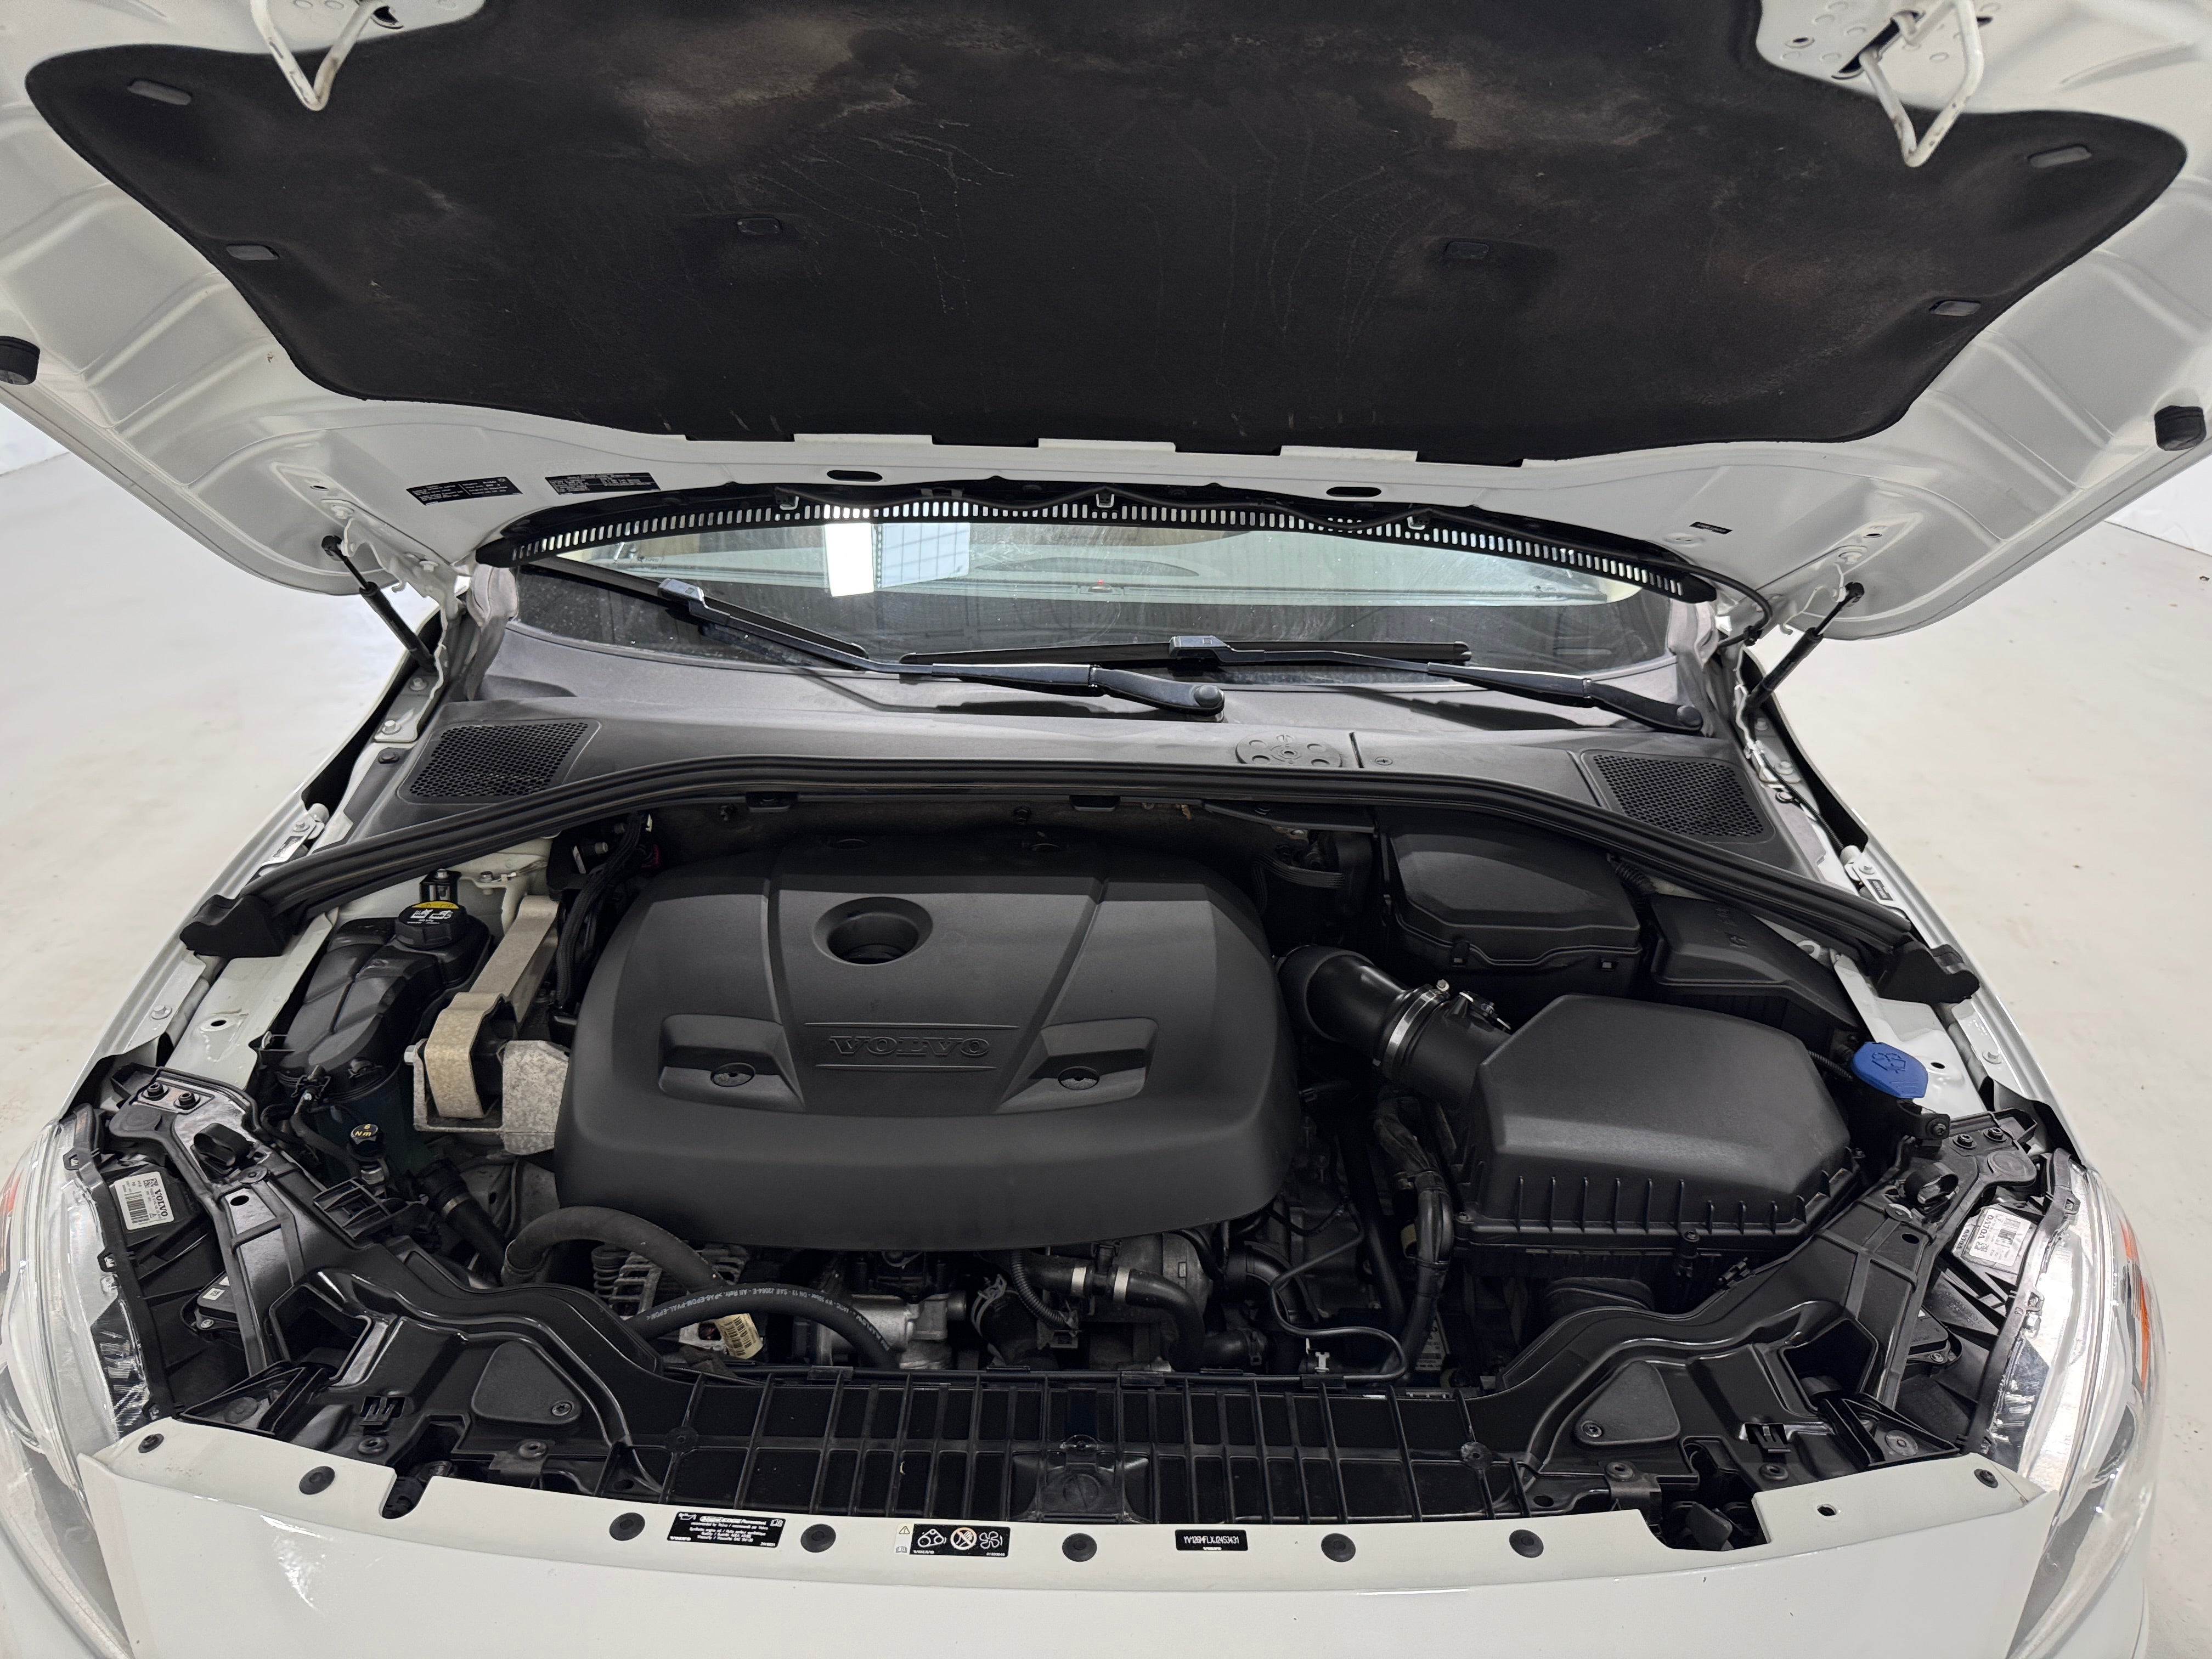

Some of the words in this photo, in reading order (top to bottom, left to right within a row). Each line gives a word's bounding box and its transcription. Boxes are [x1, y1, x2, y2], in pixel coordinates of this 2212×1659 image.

[829, 1036, 990, 1057] VOLVO
[154, 1188, 168, 1217] VOLVO
[1956, 1228, 1970, 1250] VOLVO
[1977, 1215, 1994, 1240] VOLVO
